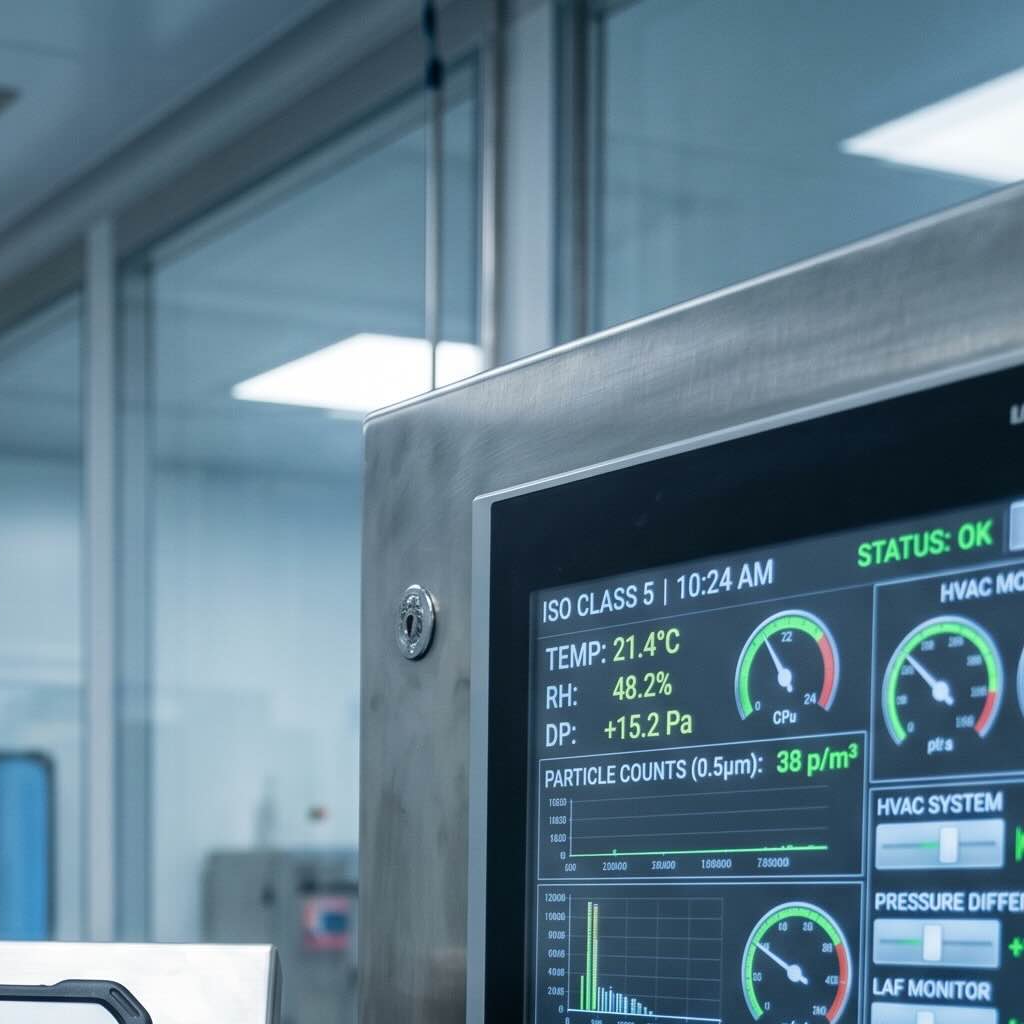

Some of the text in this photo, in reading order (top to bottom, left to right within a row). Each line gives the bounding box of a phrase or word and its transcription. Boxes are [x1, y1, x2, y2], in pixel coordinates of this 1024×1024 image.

[857, 518, 993, 567] STATUS: OK
[543, 598, 572, 623] ISO
[577, 585, 637, 617] CLASS
[643, 581, 655, 606] 5
[676, 567, 733, 599] 10:24
[737, 558, 774, 589] AM
[941, 576, 992, 603] HVAC
[781, 631, 793, 642] 22
[546, 641, 607, 672] TEMP:
[546, 671, 673, 709] RH: 48.2%
[545, 711, 693, 747] DP: +15.2 Pa
[545, 765, 616, 788] PARTICLE
[619, 759, 687, 784] COUNTS
[691, 752, 763, 782] (0.5µm):
[776, 749, 802, 773] 38
[877, 791, 1004, 816] HVAC SYSTEM
[874, 892, 965, 912] PRESSURE
[873, 977, 991, 1001] LAF MONITOR
